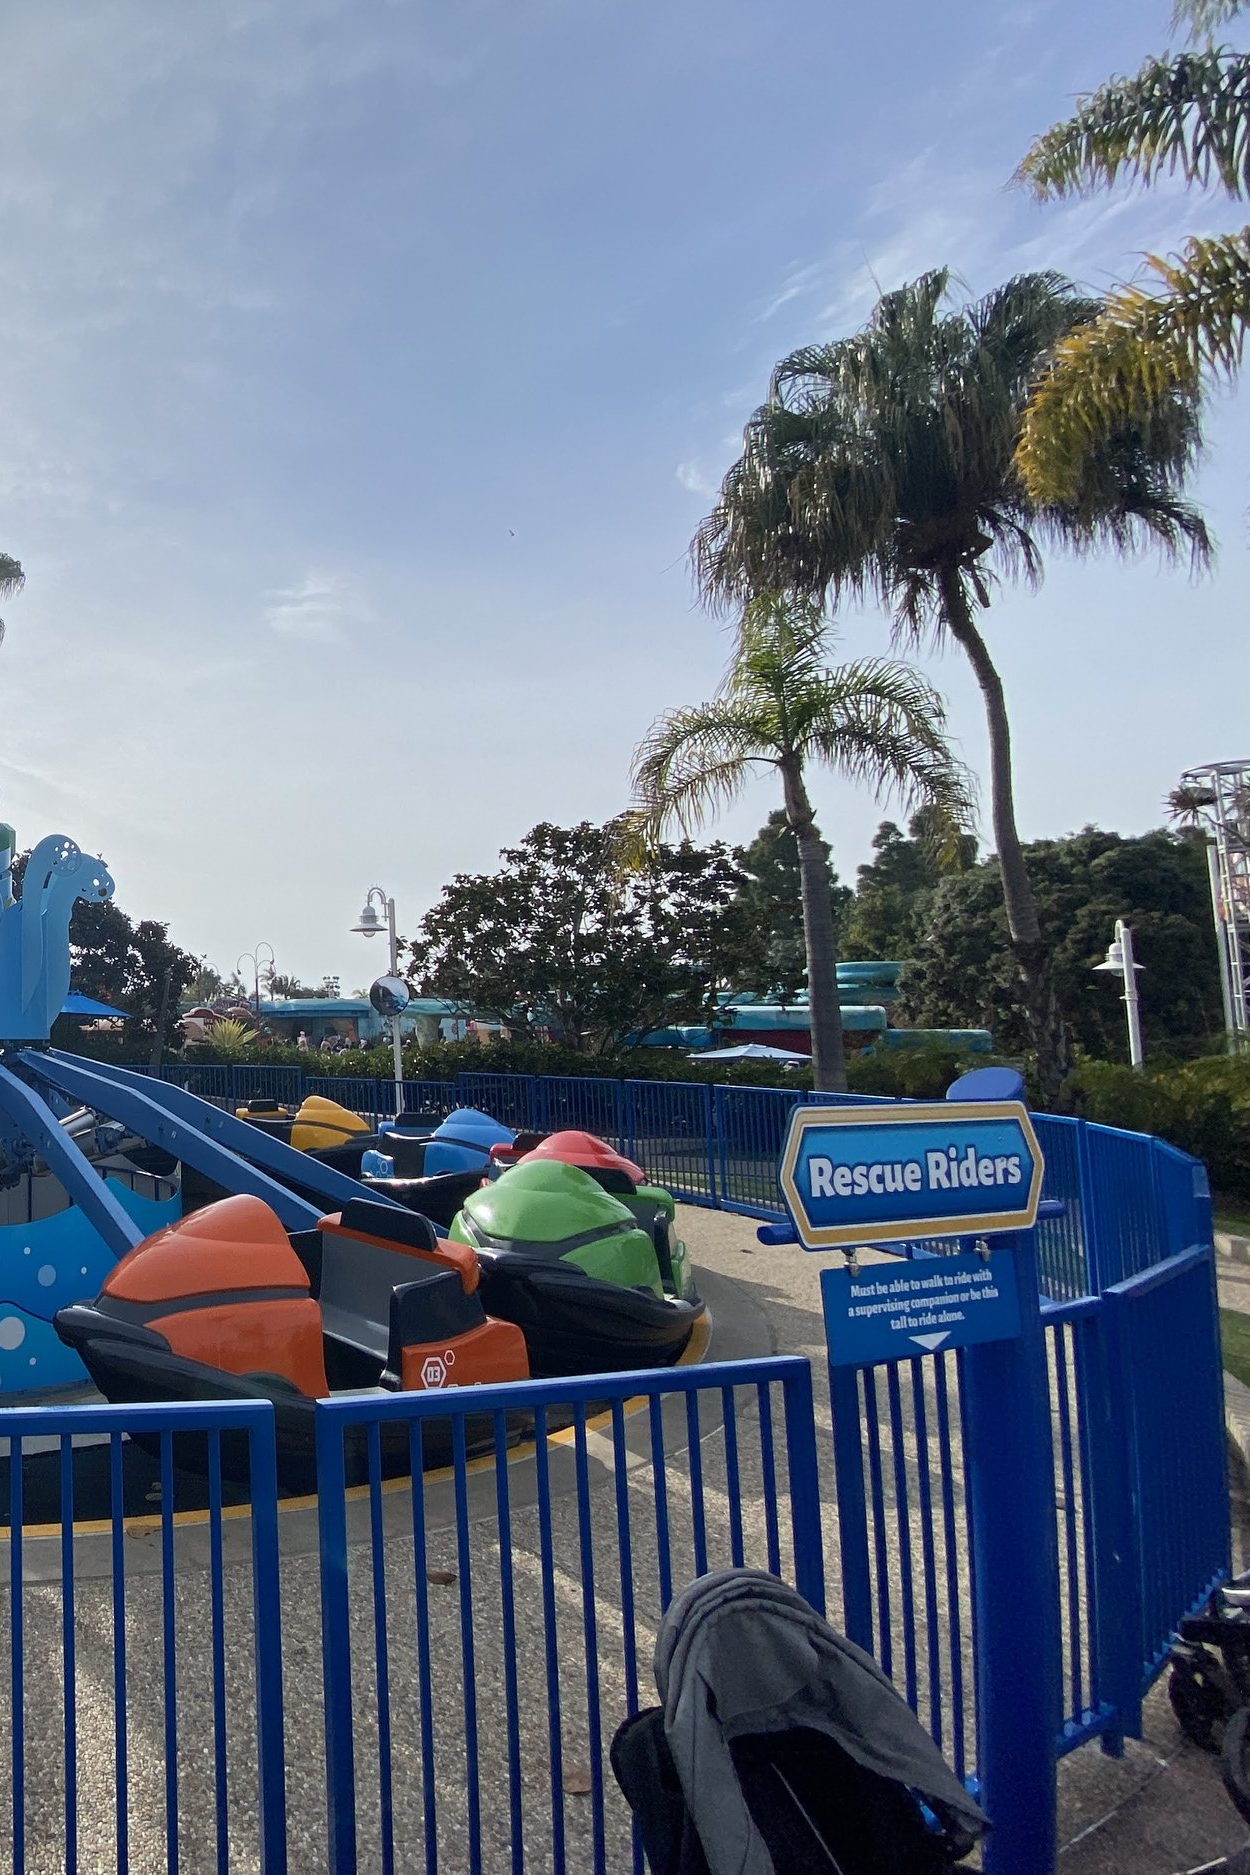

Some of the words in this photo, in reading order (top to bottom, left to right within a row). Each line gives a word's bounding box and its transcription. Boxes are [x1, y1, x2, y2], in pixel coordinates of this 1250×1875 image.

[809, 1157, 922, 1197] Rescue
[926, 1147, 1022, 1189] Riders
[850, 1284, 875, 1298] Must
[876, 1282, 888, 1294] be
[889, 1279, 910, 1292] able
[910, 1279, 920, 1291] to
[921, 1275, 944, 1289] walk
[944, 1275, 953, 1286] to
[953, 1271, 972, 1285] ride
[972, 1268, 992, 1282] with
[848, 1307, 854, 1317] a
[855, 1298, 910, 1318] supervising
[911, 1292, 960, 1311] companion
[960, 1292, 969, 1303] or
[970, 1288, 981, 1301] be
[981, 1285, 999, 1299] this
[890, 1316, 907, 1330] tall
[908, 1315, 918, 1327] to
[919, 1311, 937, 1326] ride
[938, 1310, 965, 1323] alone.
[427, 1366, 440, 1382] 03
